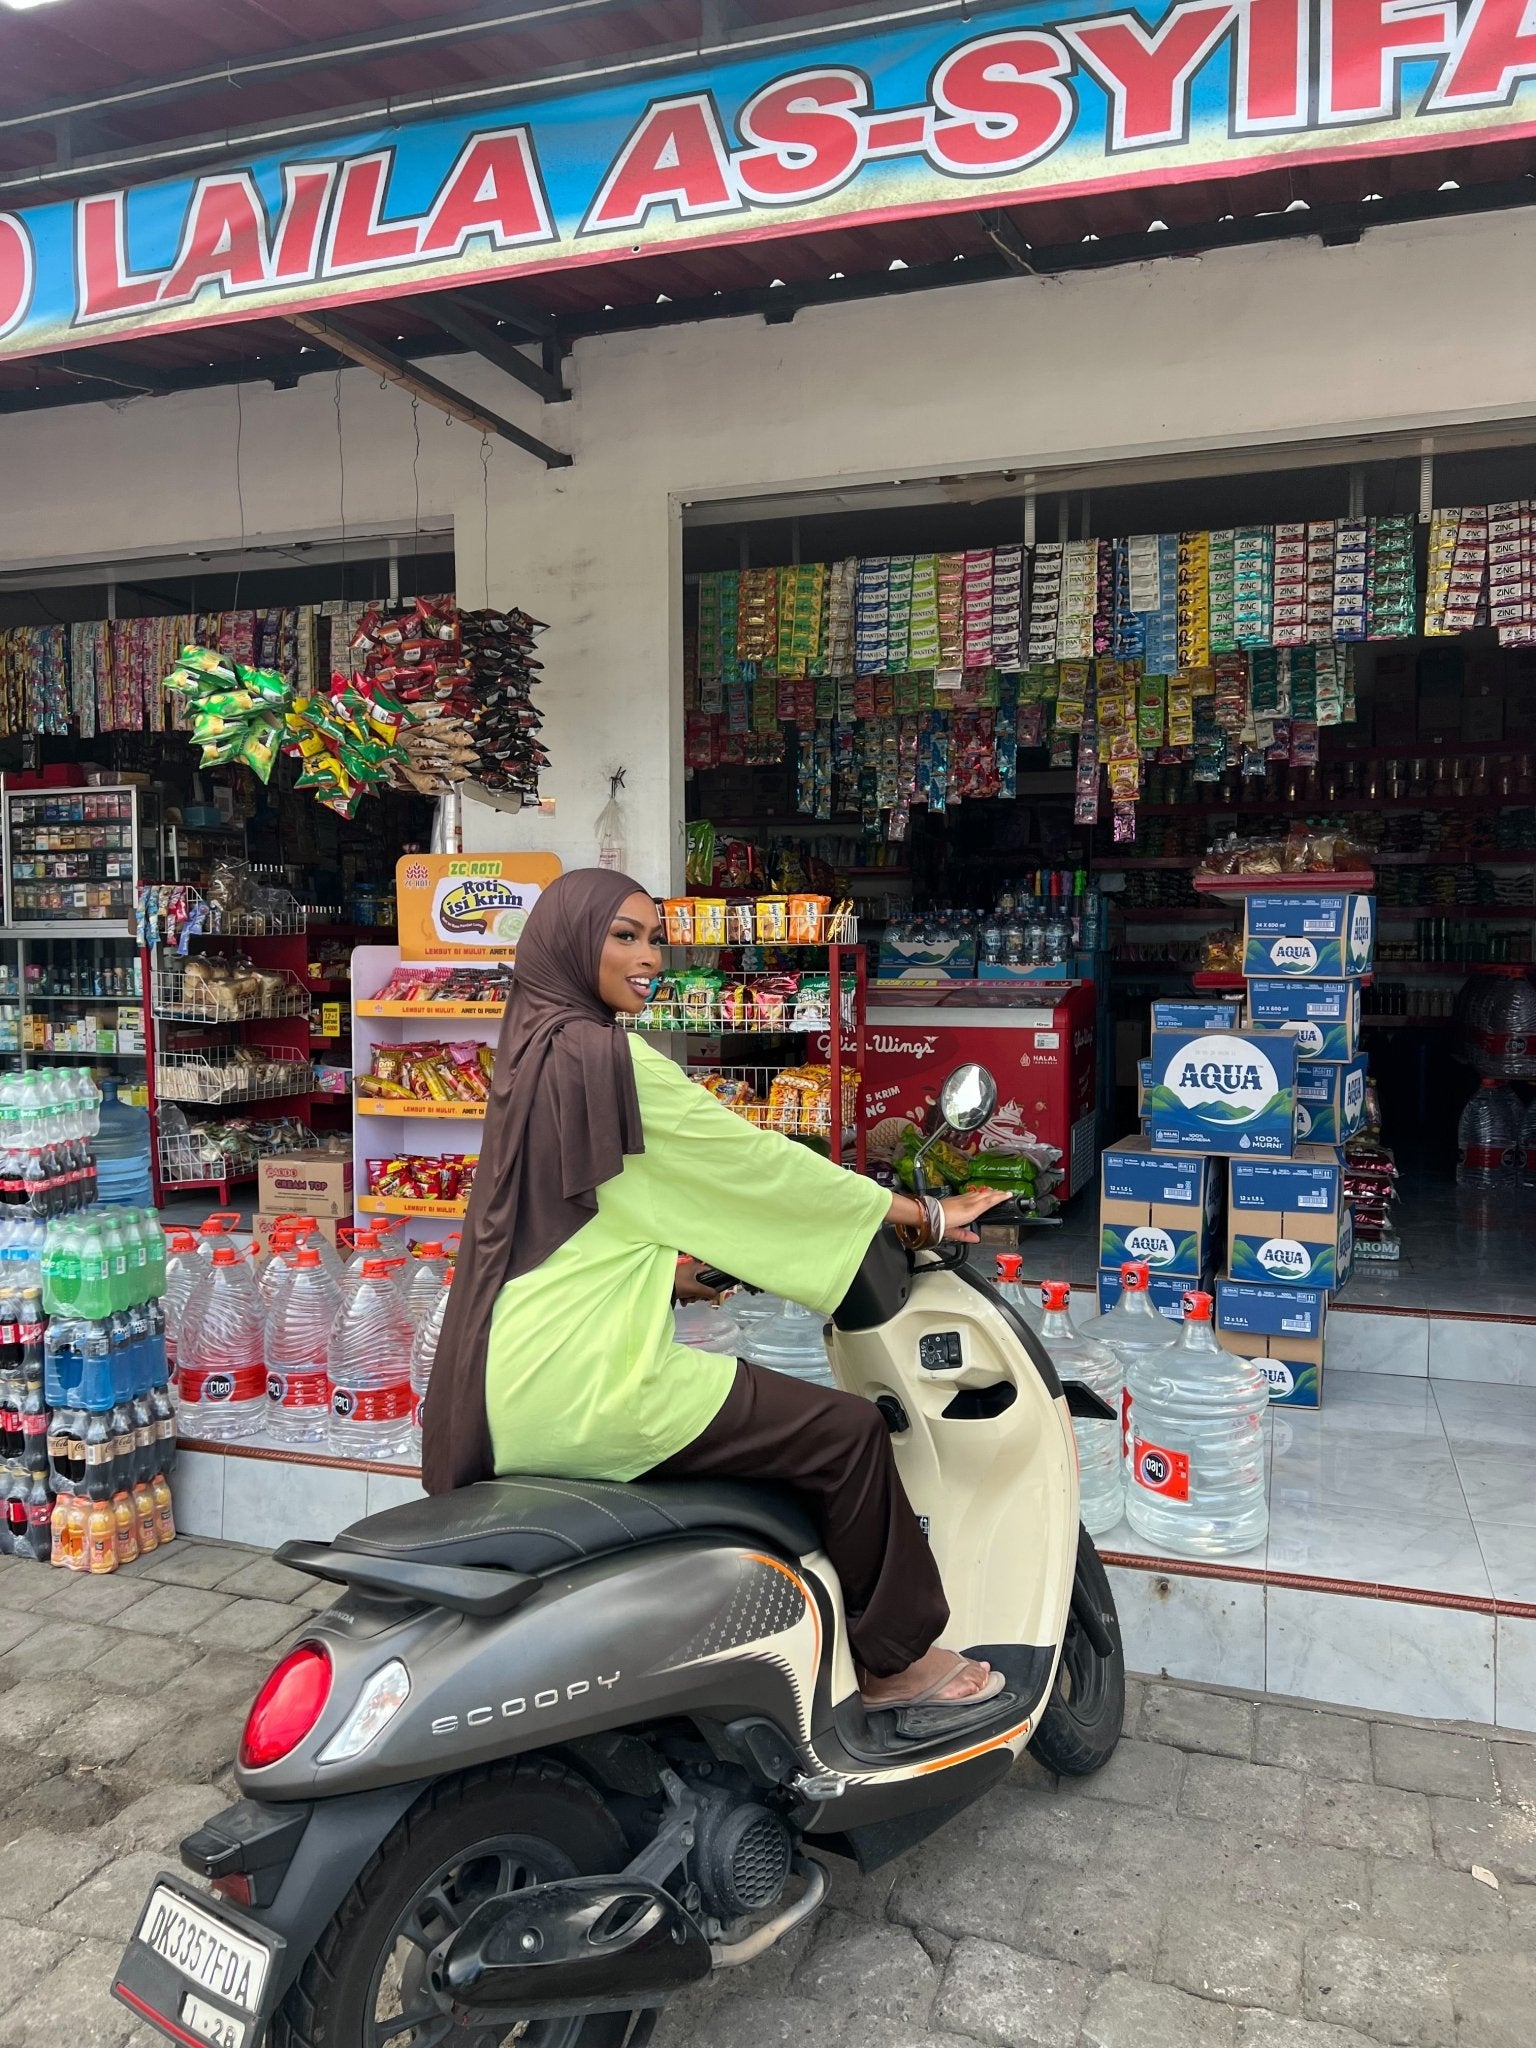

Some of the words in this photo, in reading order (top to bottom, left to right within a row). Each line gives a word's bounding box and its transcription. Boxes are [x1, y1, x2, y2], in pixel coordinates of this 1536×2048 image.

[71, 123, 559, 329] LAILA
[451, 863, 467, 875] ZC
[470, 862, 501, 875] ROTI
[462, 880, 498, 895] Roti
[447, 896, 468, 915] isi
[474, 891, 523, 907] krim
[1276, 946, 1311, 959] AQUA
[1179, 1063, 1263, 1094] AQUA
[875, 1086, 900, 1101] KRIM
[275, 1179, 307, 1190] CREAM
[308, 1181, 328, 1191] TOP
[1131, 1237, 1168, 1252] AQUA
[1264, 1249, 1303, 1265] AQUA
[210, 1381, 230, 1393] Cleo
[432, 1670, 621, 1736] SCOOPY
[148, 1904, 251, 2008] DK3357FDA
